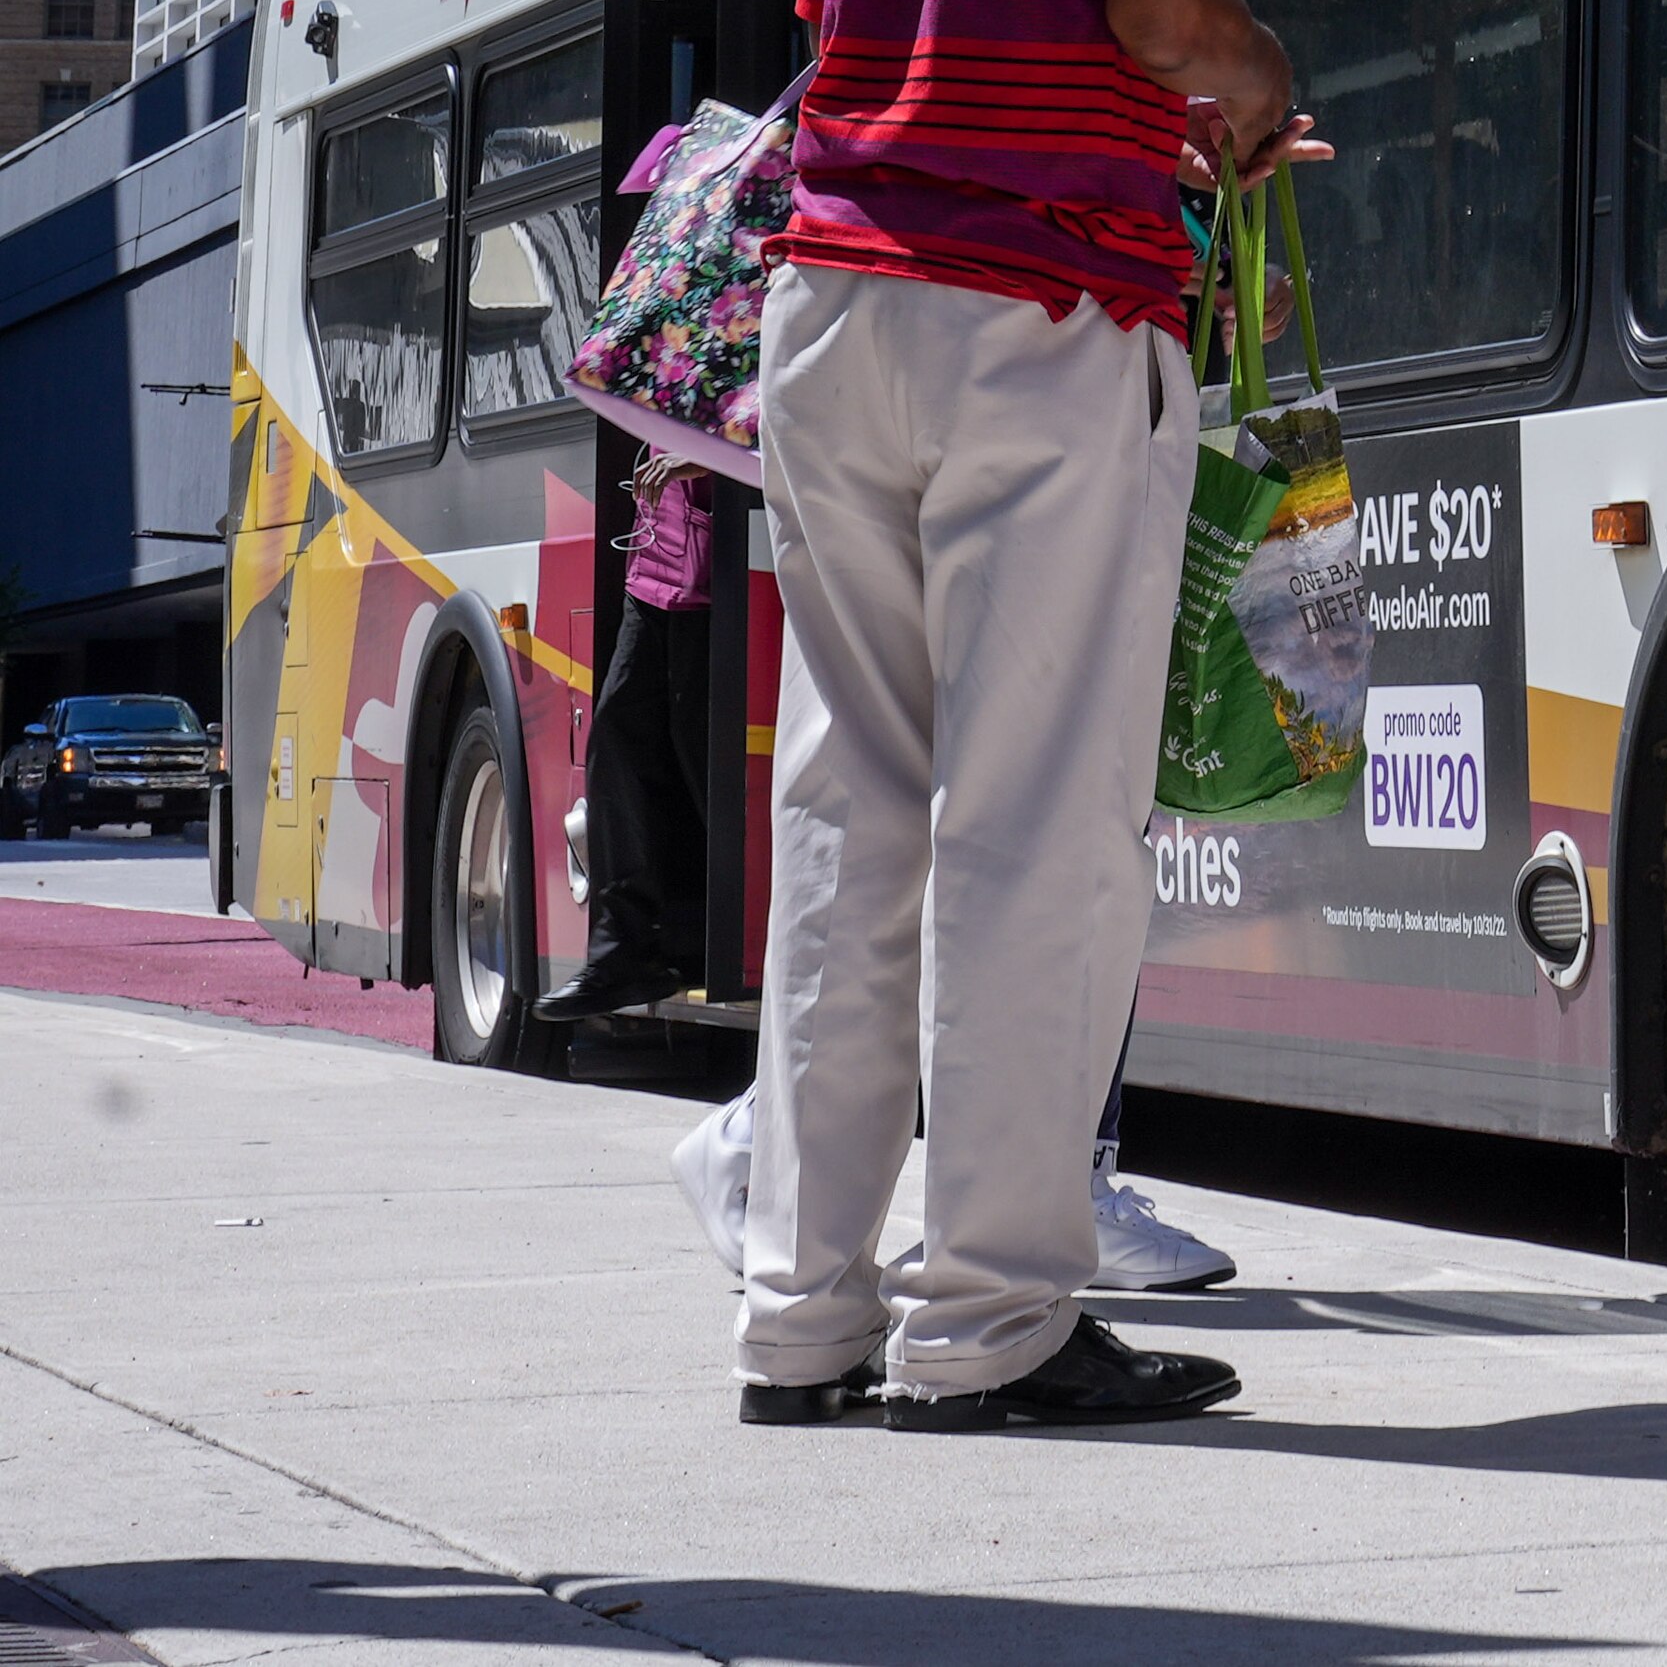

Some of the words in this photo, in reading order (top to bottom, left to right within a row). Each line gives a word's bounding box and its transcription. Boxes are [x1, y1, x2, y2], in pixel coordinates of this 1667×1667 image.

[1187, 510, 1209, 533] THIS
[1352, 491, 1420, 567] AVE
[1290, 569, 1326, 597] ONE
[1326, 557, 1361, 586] BA
[1368, 582, 1491, 631] AveloAir.com
[1384, 712, 1426, 746] promo
[1429, 701, 1461, 736] code
[1182, 747, 1225, 779] Gant
[1371, 753, 1479, 830] BWI20
[1143, 816, 1241, 908] ches
[1349, 906, 1363, 931] trip
[1363, 906, 1386, 932] flights
[1386, 908, 1405, 933] only.
[1405, 909, 1424, 931] Book
[1424, 911, 1439, 932] and
[1439, 912, 1462, 934] travel
[1462, 912, 1473, 938] by
[1473, 913, 1508, 937] 10/31/22.
